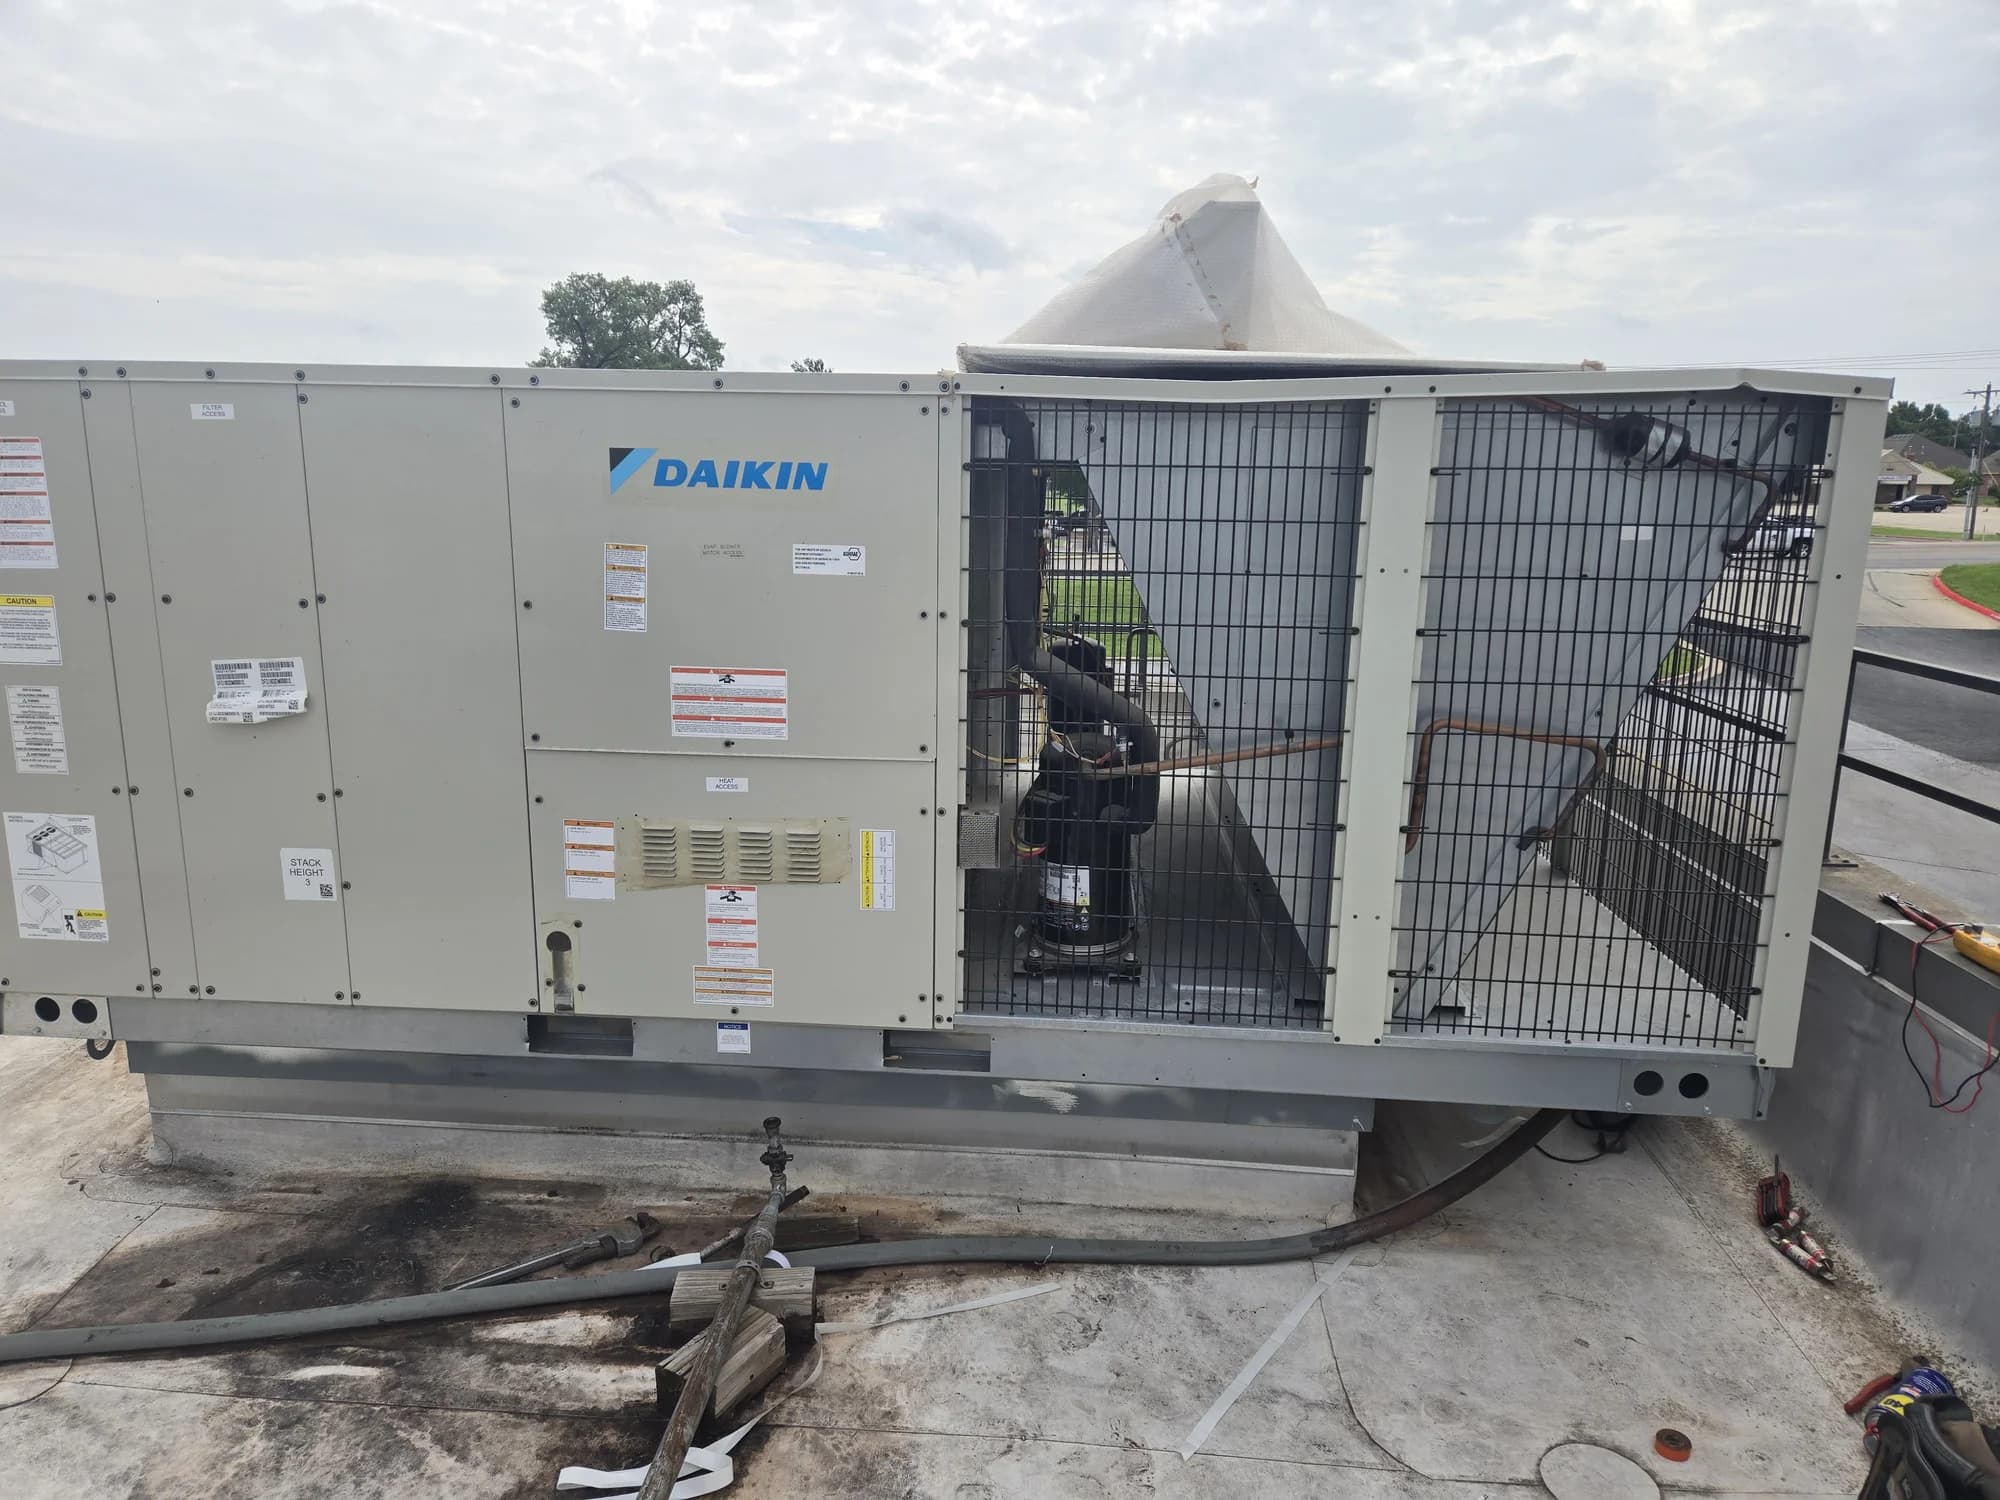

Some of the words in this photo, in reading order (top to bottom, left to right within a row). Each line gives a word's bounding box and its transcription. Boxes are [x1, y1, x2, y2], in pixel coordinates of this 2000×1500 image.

[653, 459, 829, 490] DAIKIN
[290, 858, 322, 867] STACK
[289, 868, 324, 877] HEIGHT
[304, 878, 311, 886] 3
